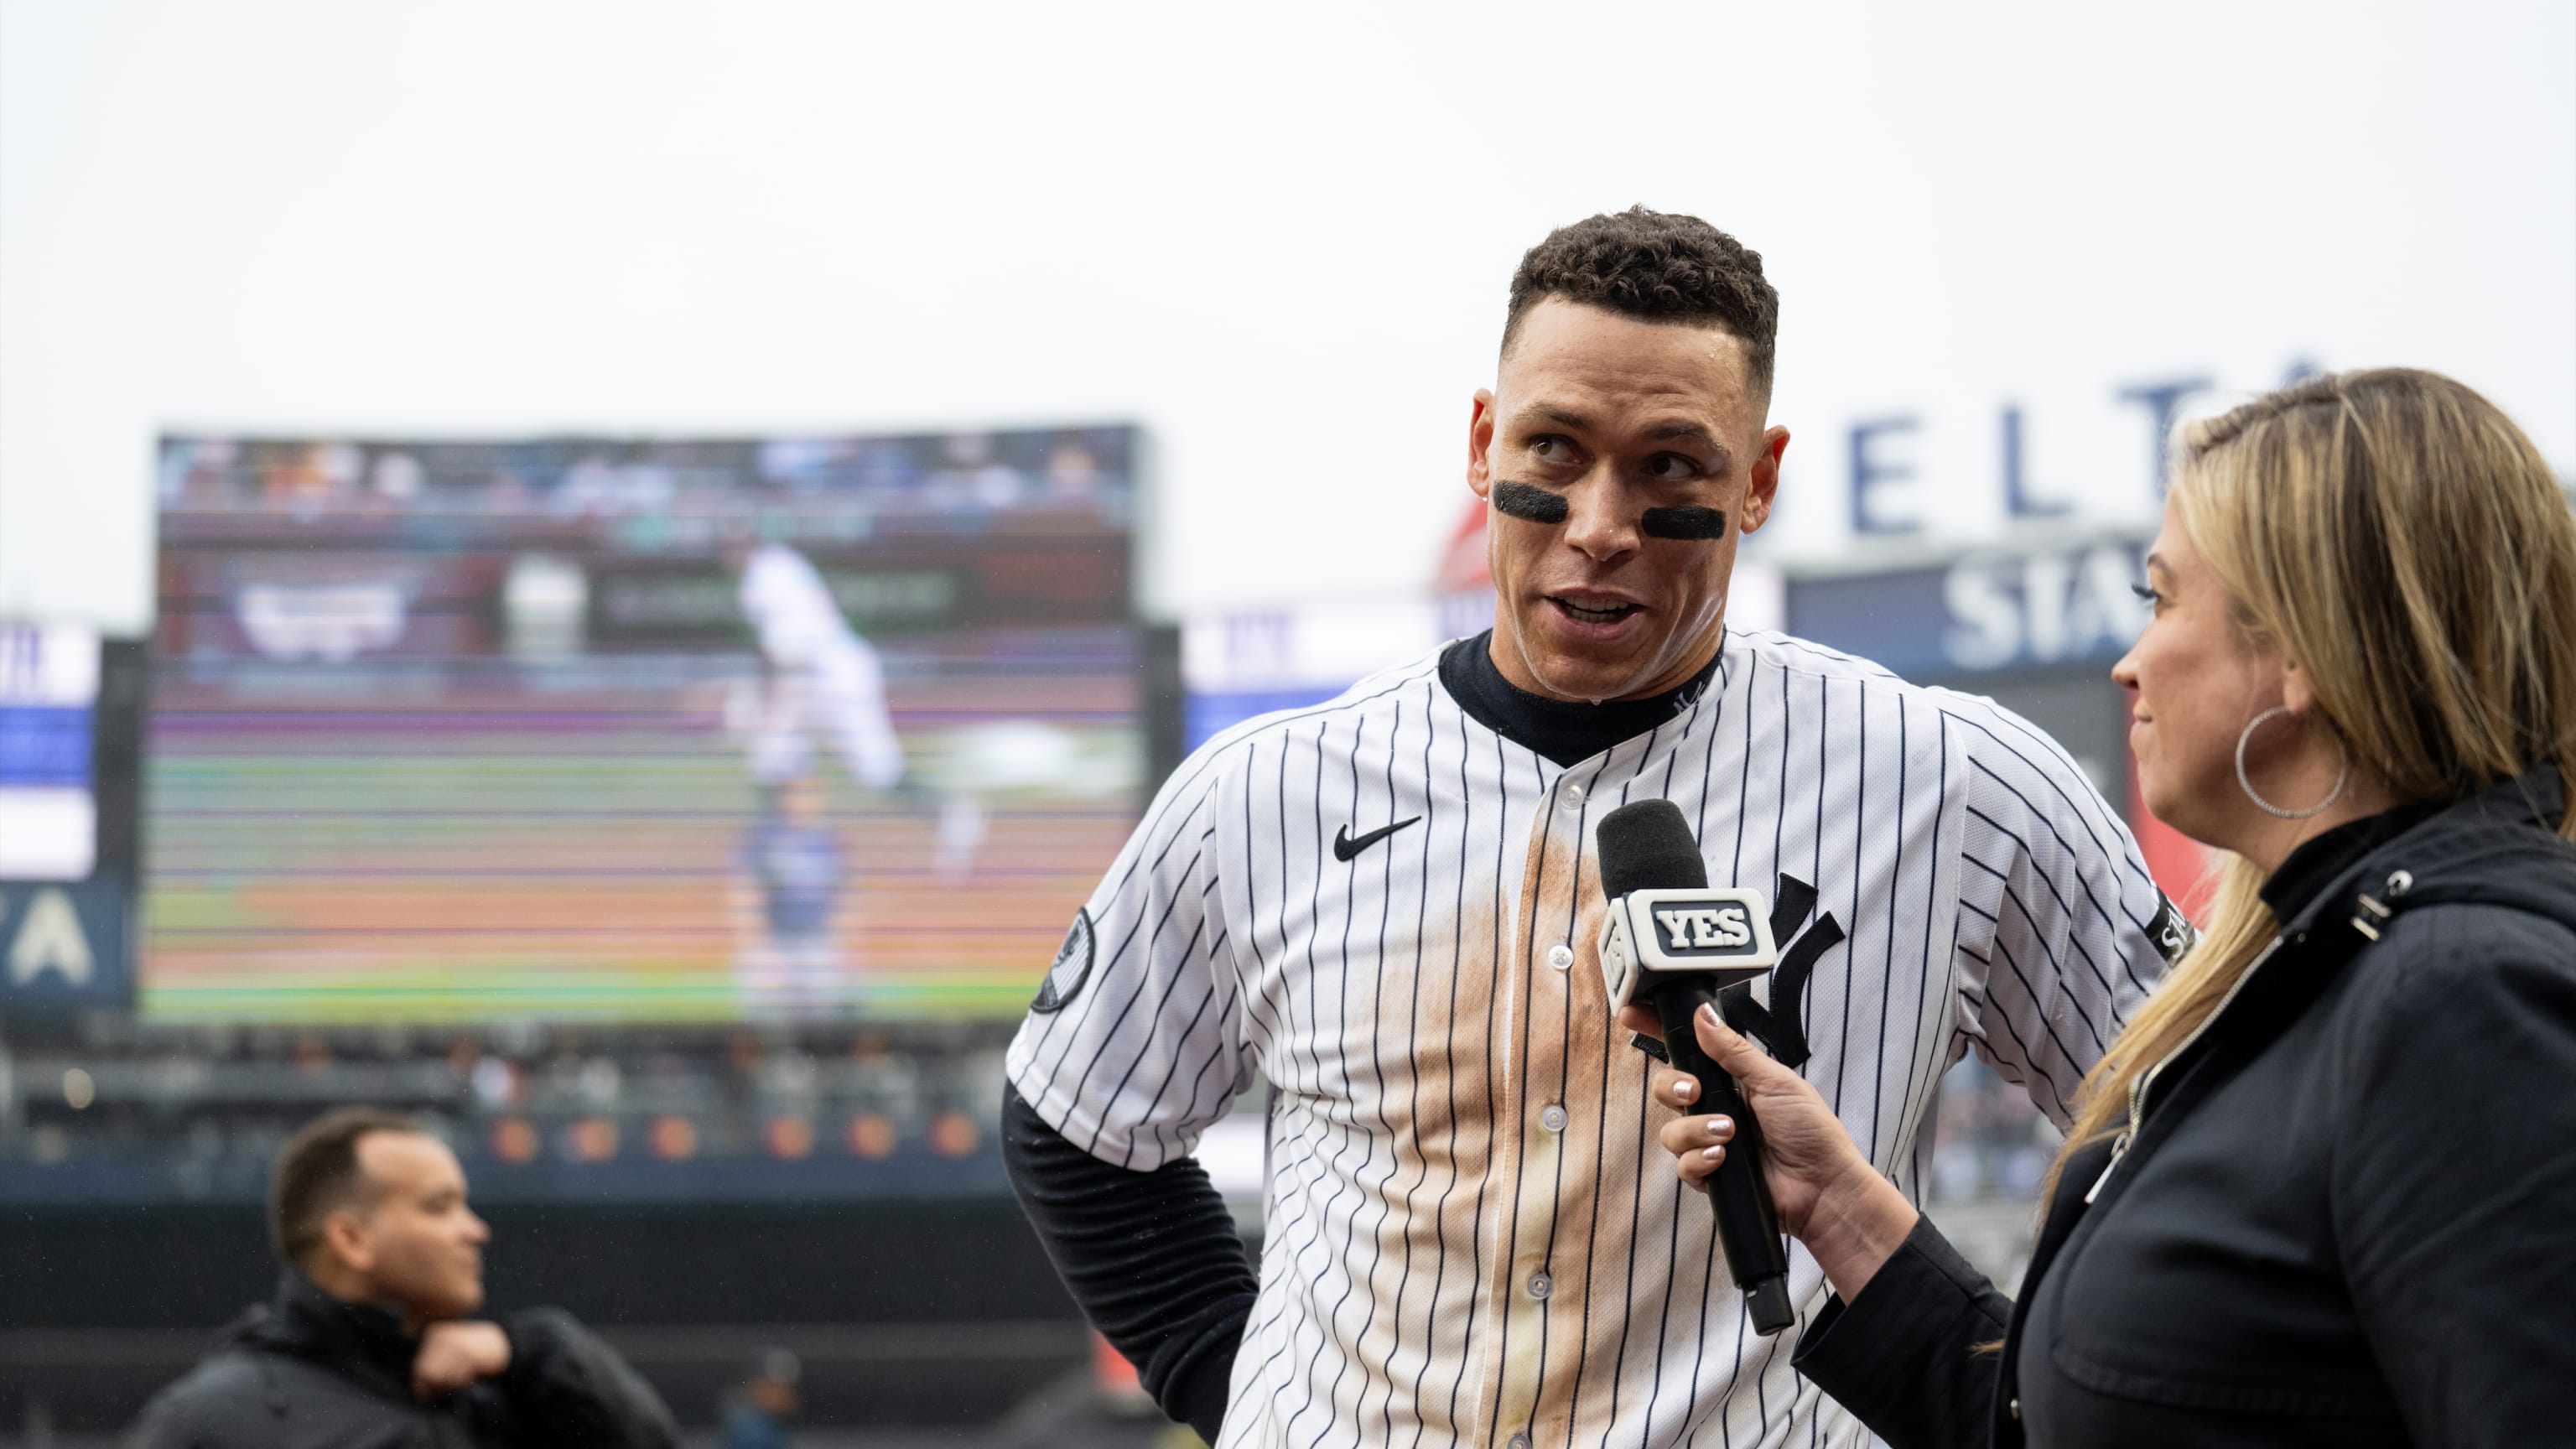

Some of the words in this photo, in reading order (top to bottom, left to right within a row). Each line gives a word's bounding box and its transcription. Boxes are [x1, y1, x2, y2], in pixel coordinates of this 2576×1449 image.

[1748, 357, 2321, 541] ELT
[0, 886, 96, 986] A
[1655, 908, 1751, 948] YES
